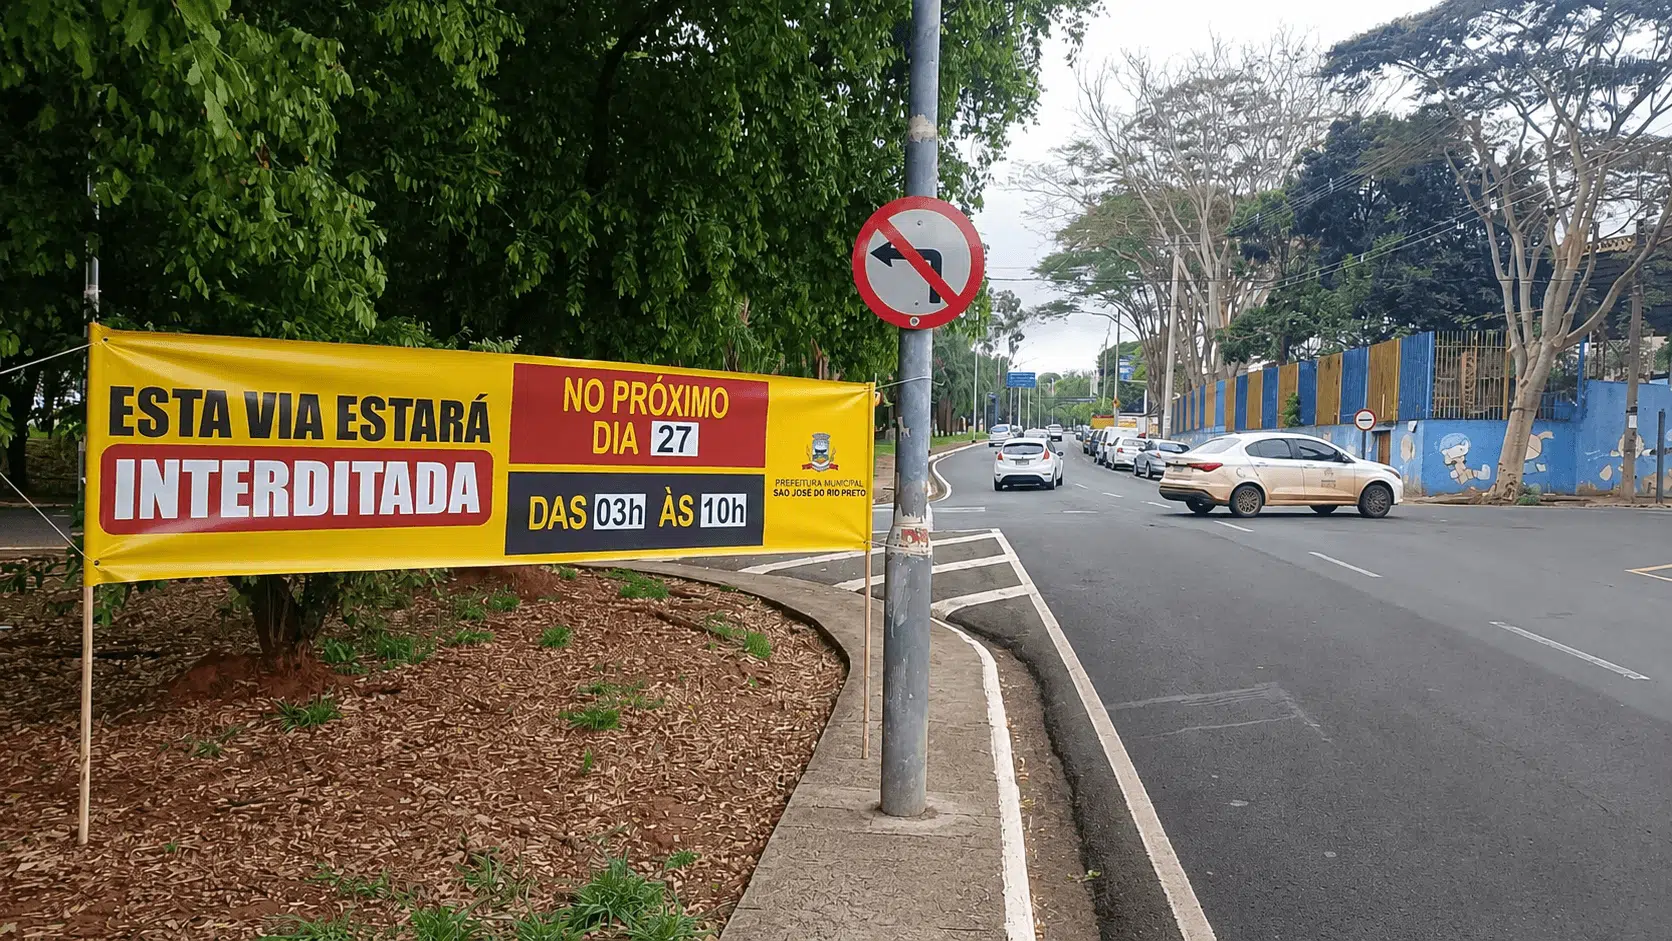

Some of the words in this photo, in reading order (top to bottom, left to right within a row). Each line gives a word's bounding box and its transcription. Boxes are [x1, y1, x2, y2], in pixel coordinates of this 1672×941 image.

[109, 385, 231, 438] ESTA
[244, 391, 324, 440] VIA
[336, 393, 491, 443] ESTARÁ
[563, 377, 604, 413] NO
[613, 375, 729, 418] PRÓXIMO
[593, 421, 639, 455] DIA
[657, 425, 692, 453] 27
[114, 458, 480, 520] INTERDITADA
[775, 479, 822, 487] PREFEITURA
[824, 479, 863, 487] MUNICIPAL
[814, 489, 825, 497] DO
[827, 489, 840, 497] RIO
[842, 489, 866, 497] PRETO
[529, 495, 587, 530] DAS
[597, 498, 643, 526] 03h
[659, 486, 694, 527] ÀS
[703, 497, 746, 526] 10h
